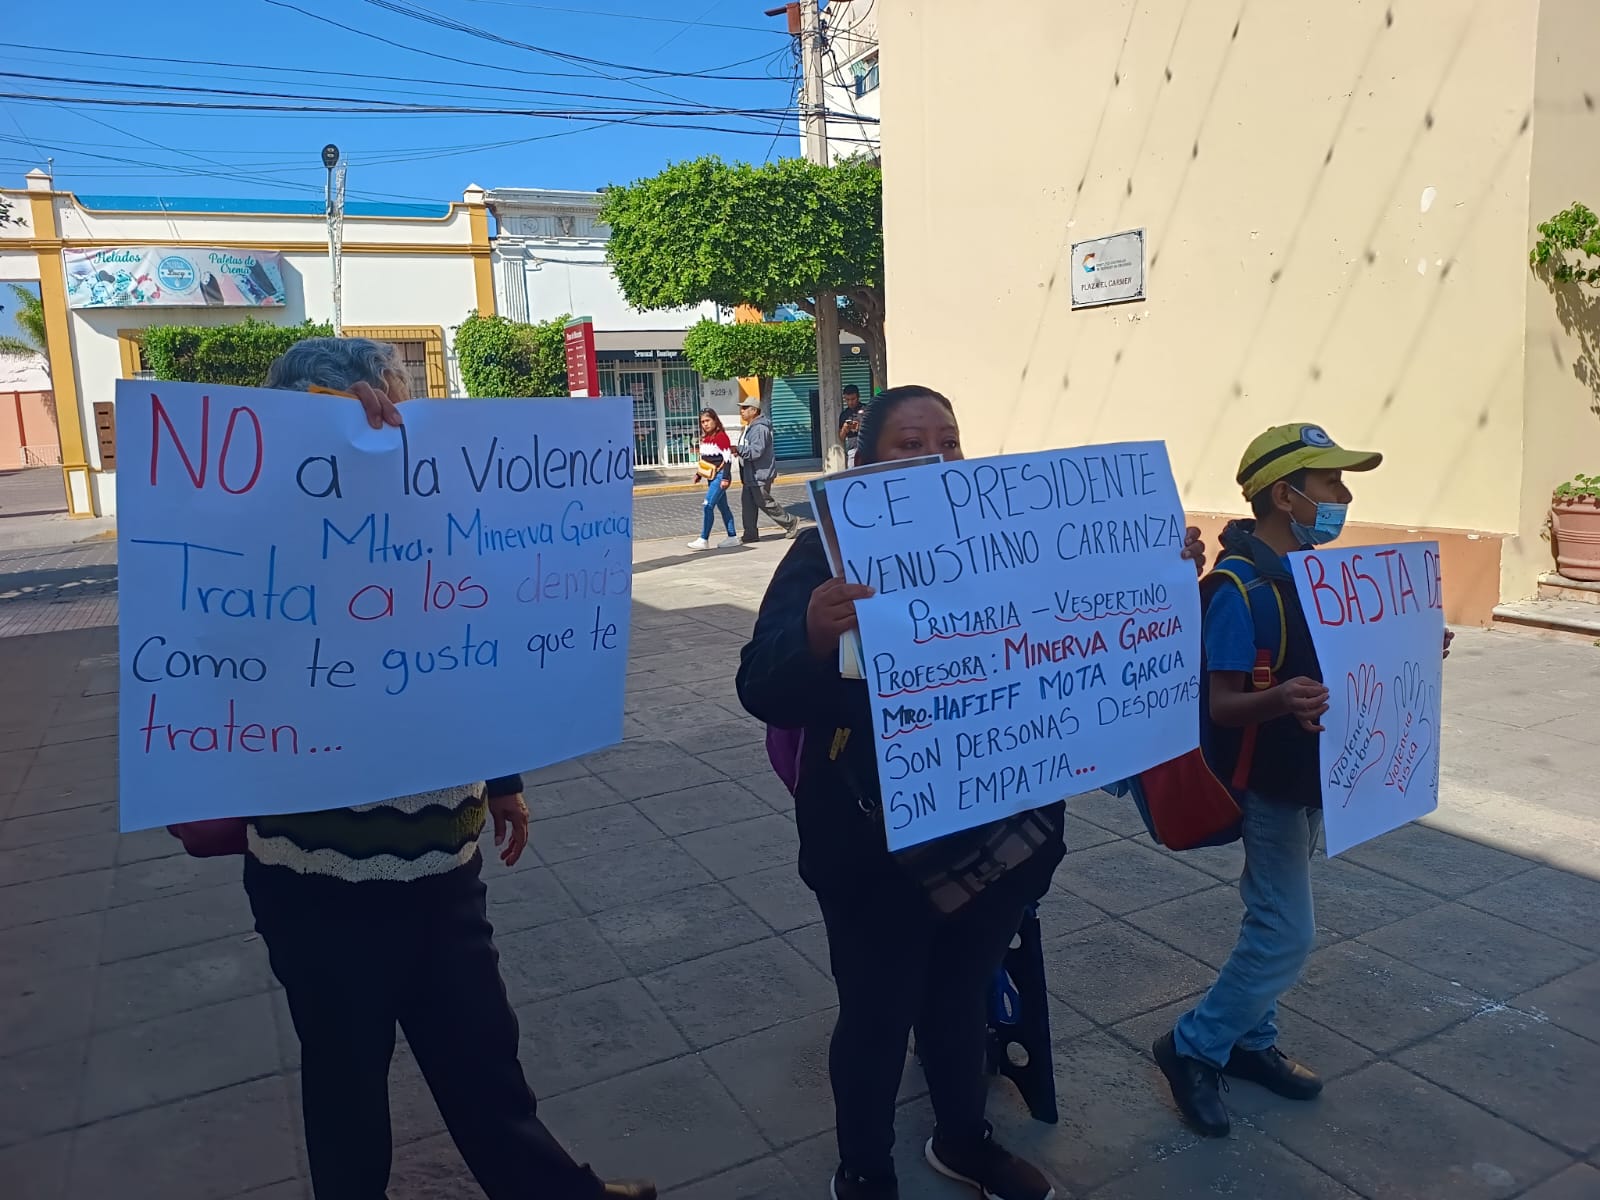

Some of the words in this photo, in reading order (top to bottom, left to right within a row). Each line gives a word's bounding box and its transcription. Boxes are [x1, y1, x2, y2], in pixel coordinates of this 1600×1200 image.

[94, 250, 141, 264] Helados
[209, 252, 243, 264] Paletas
[245, 255, 254, 265] de
[220, 263, 250, 274] Crema
[150, 393, 263, 495] NO
[296, 455, 342, 499] a
[400, 423, 441, 497] la
[461, 434, 633, 494] Violencia
[940, 452, 1157, 538] PRESIDENTE
[322, 512, 433, 563] Mtra.
[447, 508, 553, 558] Minerva
[847, 529, 1039, 595] VENUSTIANO
[1056, 513, 1184, 561] CARRANZA
[131, 538, 317, 625] Trata
[348, 583, 394, 621] a
[423, 559, 489, 612] los
[1303, 549, 1421, 627] BASTA
[132, 635, 268, 683] Como
[306, 637, 356, 688] te
[382, 623, 499, 695] gusta
[526, 626, 576, 669] que
[590, 605, 618, 651] te
[908, 598, 1020, 637] PRIMARIA
[1003, 629, 1109, 671] MINERVA
[1119, 615, 1183, 654] GARCIA
[1039, 663, 1107, 702] MOTA
[1121, 650, 1184, 691] GARCIA
[140, 693, 343, 755] traten...
[884, 738, 942, 780] SON
[955, 707, 1080, 771] PERSONAS
[1096, 674, 1200, 726] DESPOTAS
[1330, 702, 1368, 787] Violencia
[1385, 711, 1412, 786] Violencia
[889, 782, 937, 830] SIN
